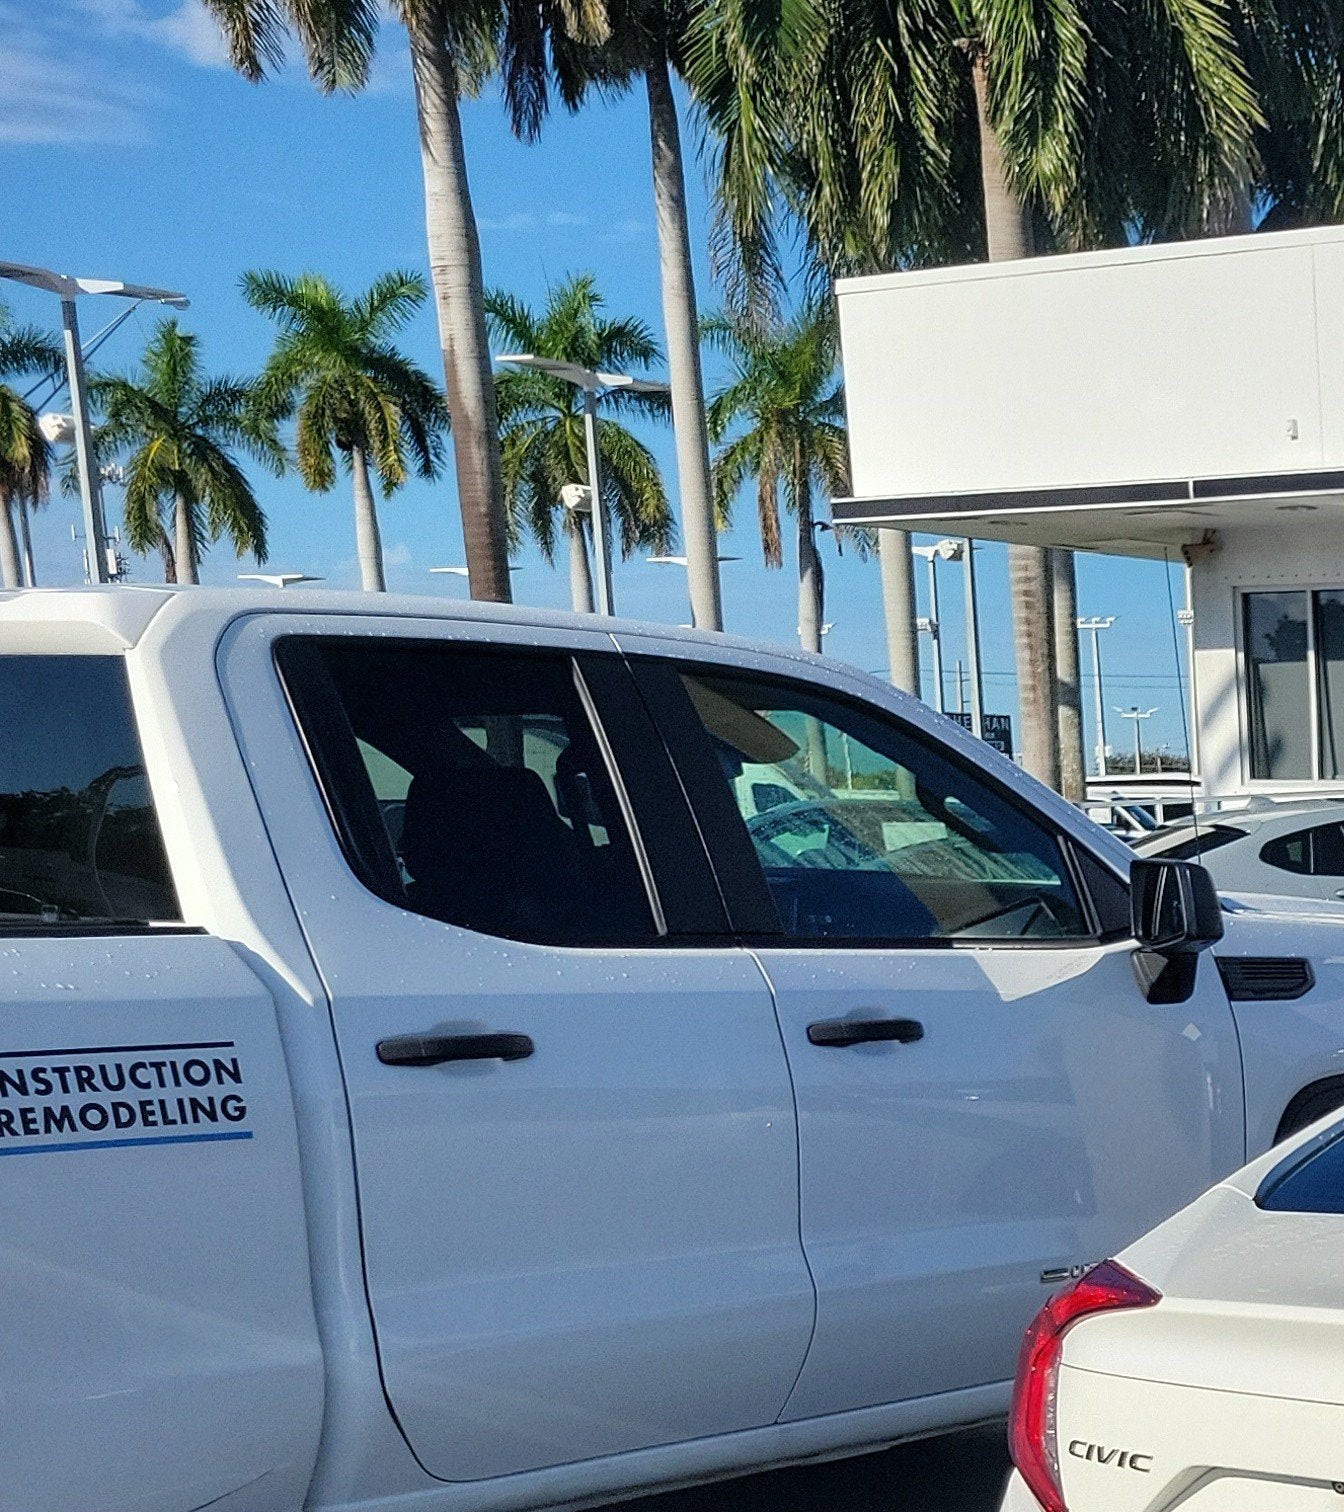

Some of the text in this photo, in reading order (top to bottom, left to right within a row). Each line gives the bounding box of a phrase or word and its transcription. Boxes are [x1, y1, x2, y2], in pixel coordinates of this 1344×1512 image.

[0, 1058, 243, 1098] NSTRUCTION
[0, 1094, 247, 1137] REMODELING
[1068, 1439, 1154, 1474] CIVIC
